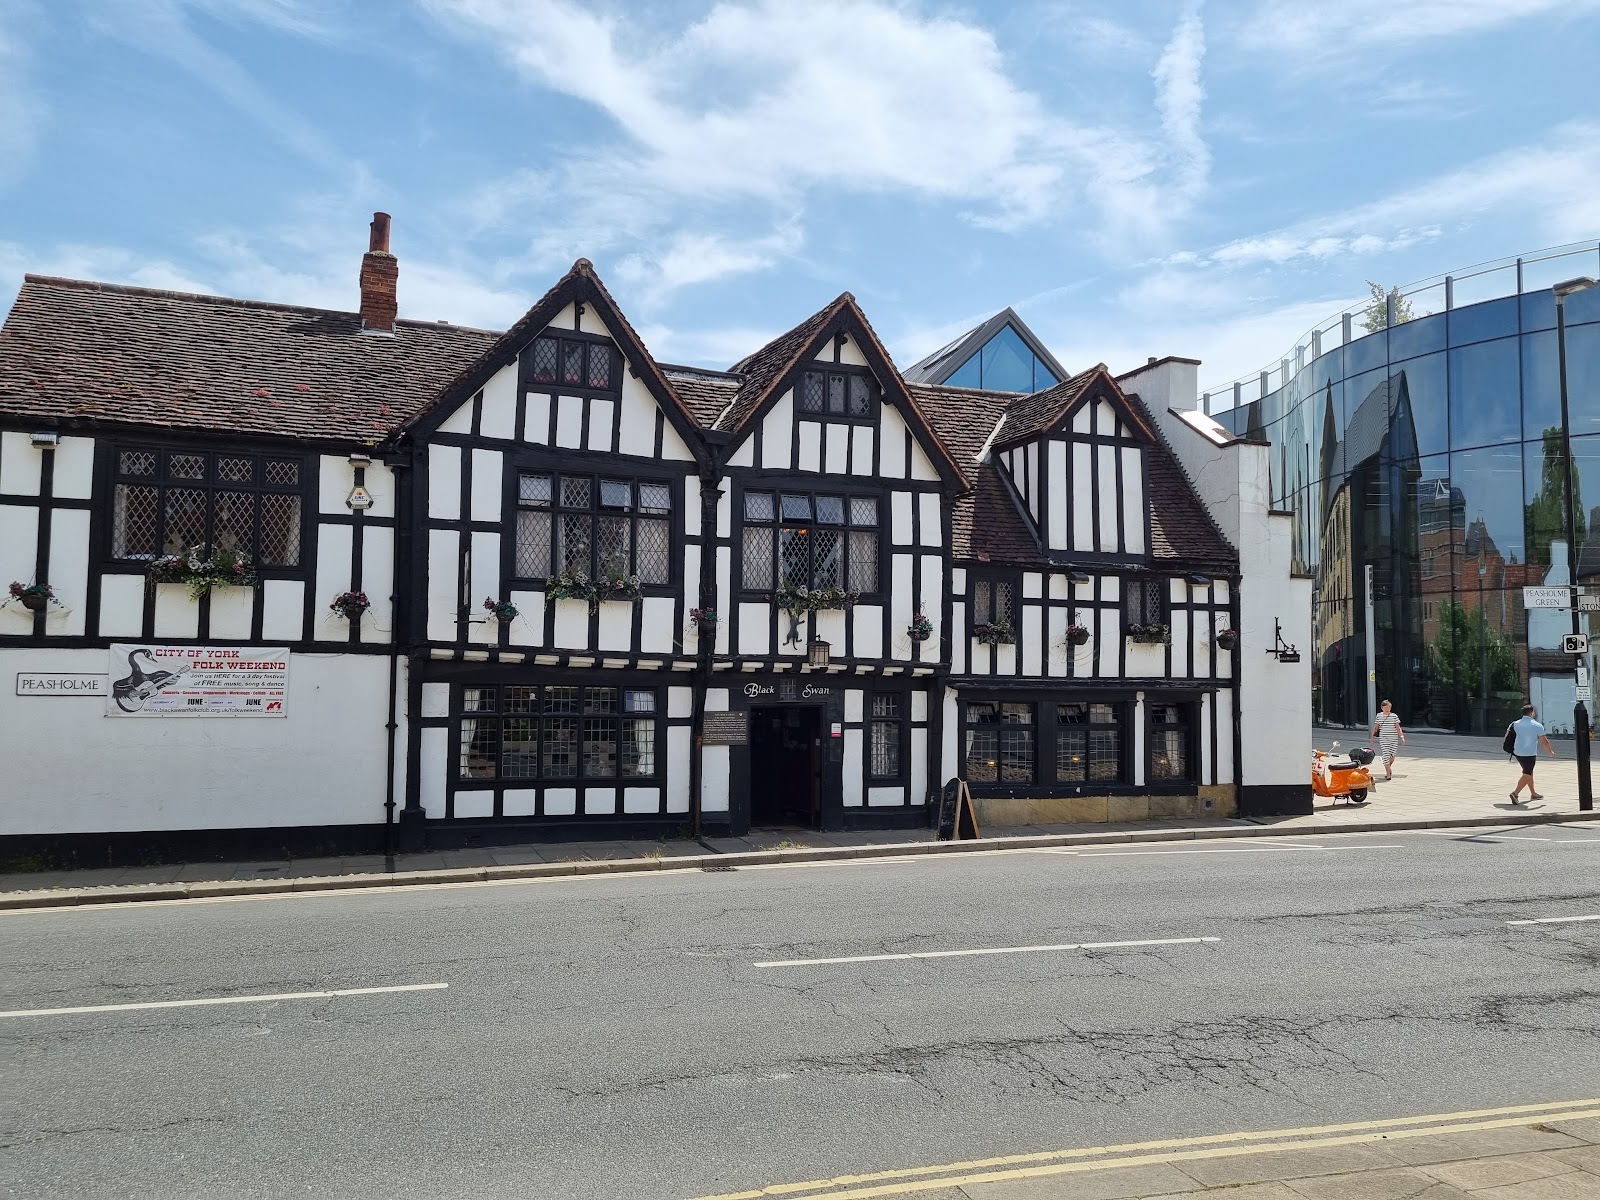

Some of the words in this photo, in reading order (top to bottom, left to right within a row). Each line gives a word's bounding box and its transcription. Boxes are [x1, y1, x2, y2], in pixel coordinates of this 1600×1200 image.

[187, 650, 203, 658] OF
[206, 650, 240, 658] YORK
[192, 661, 224, 670] FOLK
[227, 662, 286, 670] WEEKEND
[22, 680, 99, 689] PEASHOLME
[743, 682, 775, 698] Black
[801, 683, 830, 698] Swan
